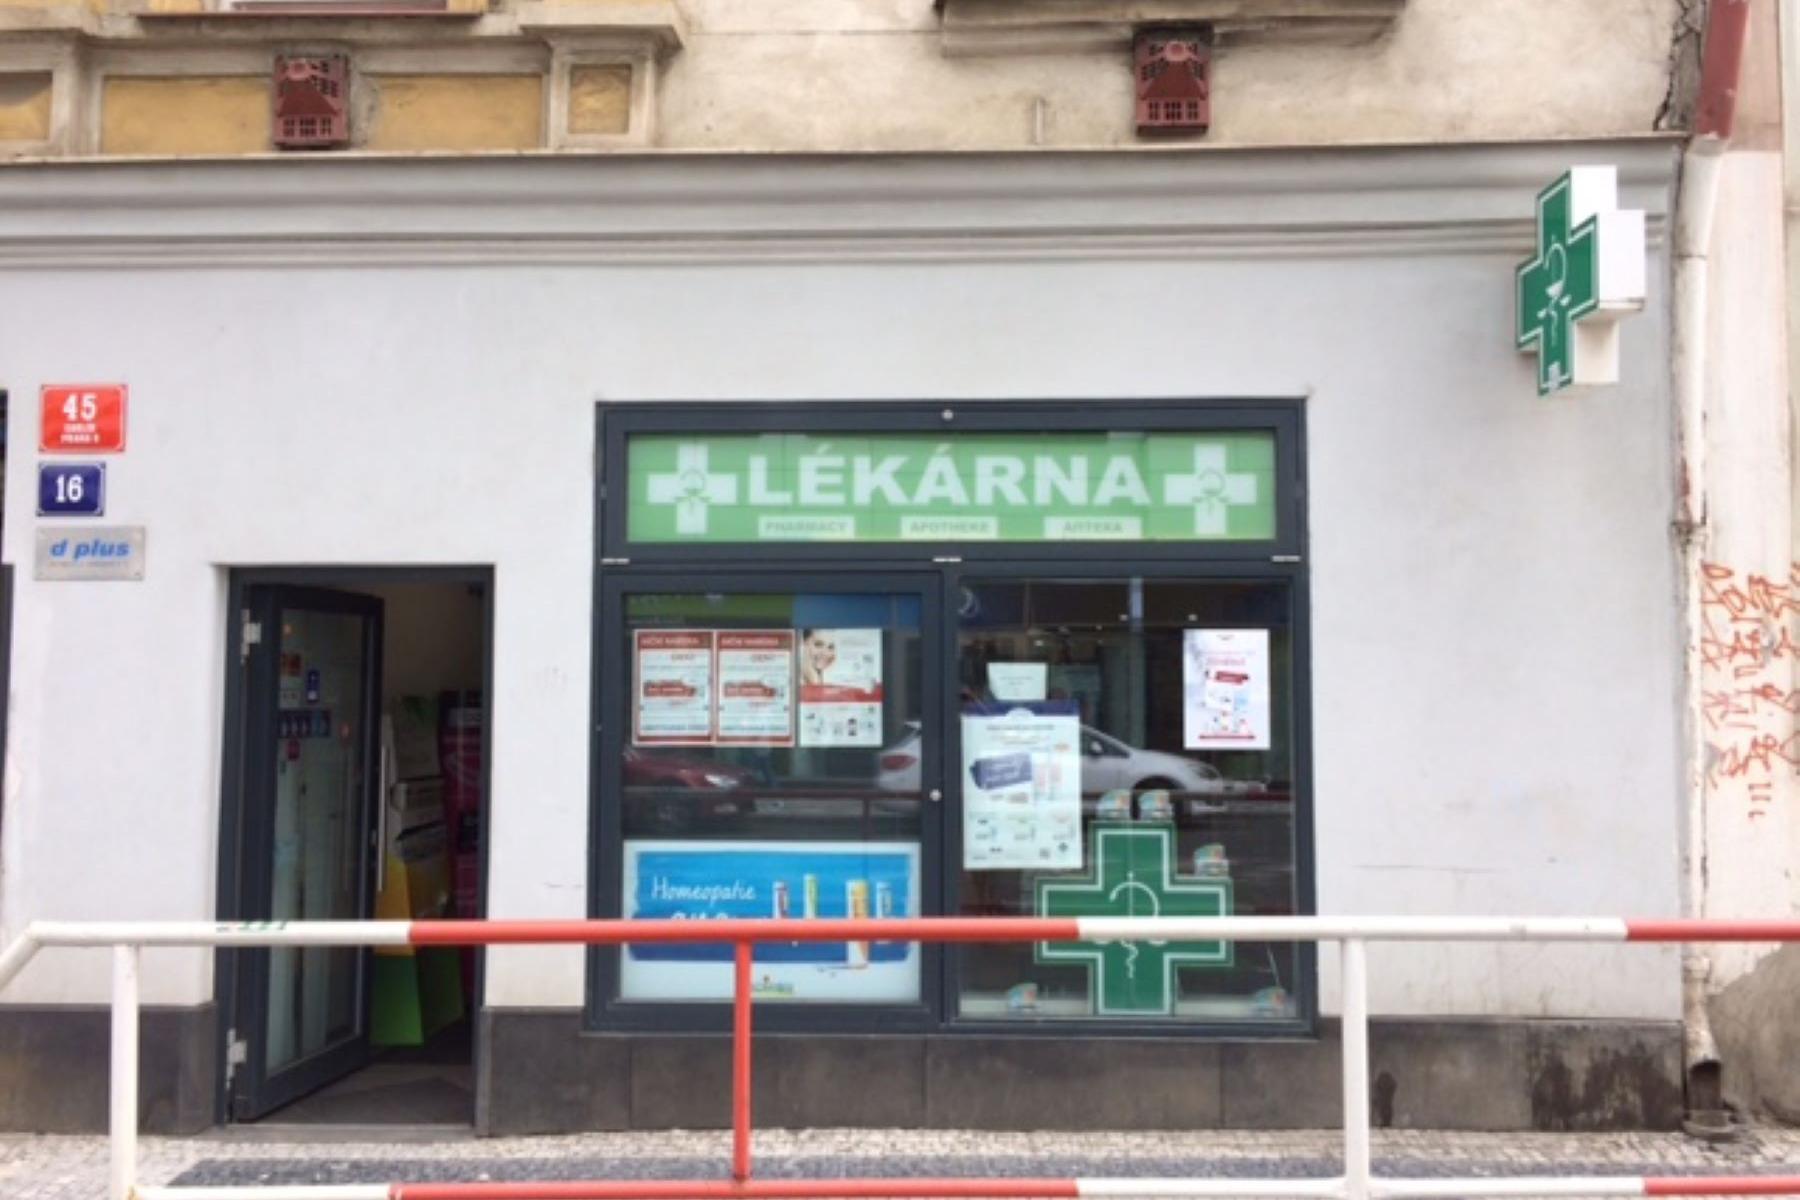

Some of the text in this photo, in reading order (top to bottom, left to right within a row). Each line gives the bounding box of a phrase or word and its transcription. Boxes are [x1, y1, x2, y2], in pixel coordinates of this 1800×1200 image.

[62, 392, 98, 421] 45
[55, 473, 84, 503] 16
[748, 443, 1151, 506] LÉKÁRNA
[765, 520, 848, 533] PHARMACY
[910, 520, 990, 534] APOTHEKE
[51, 539, 130, 560] d plus
[651, 876, 756, 908] Homeopatie
